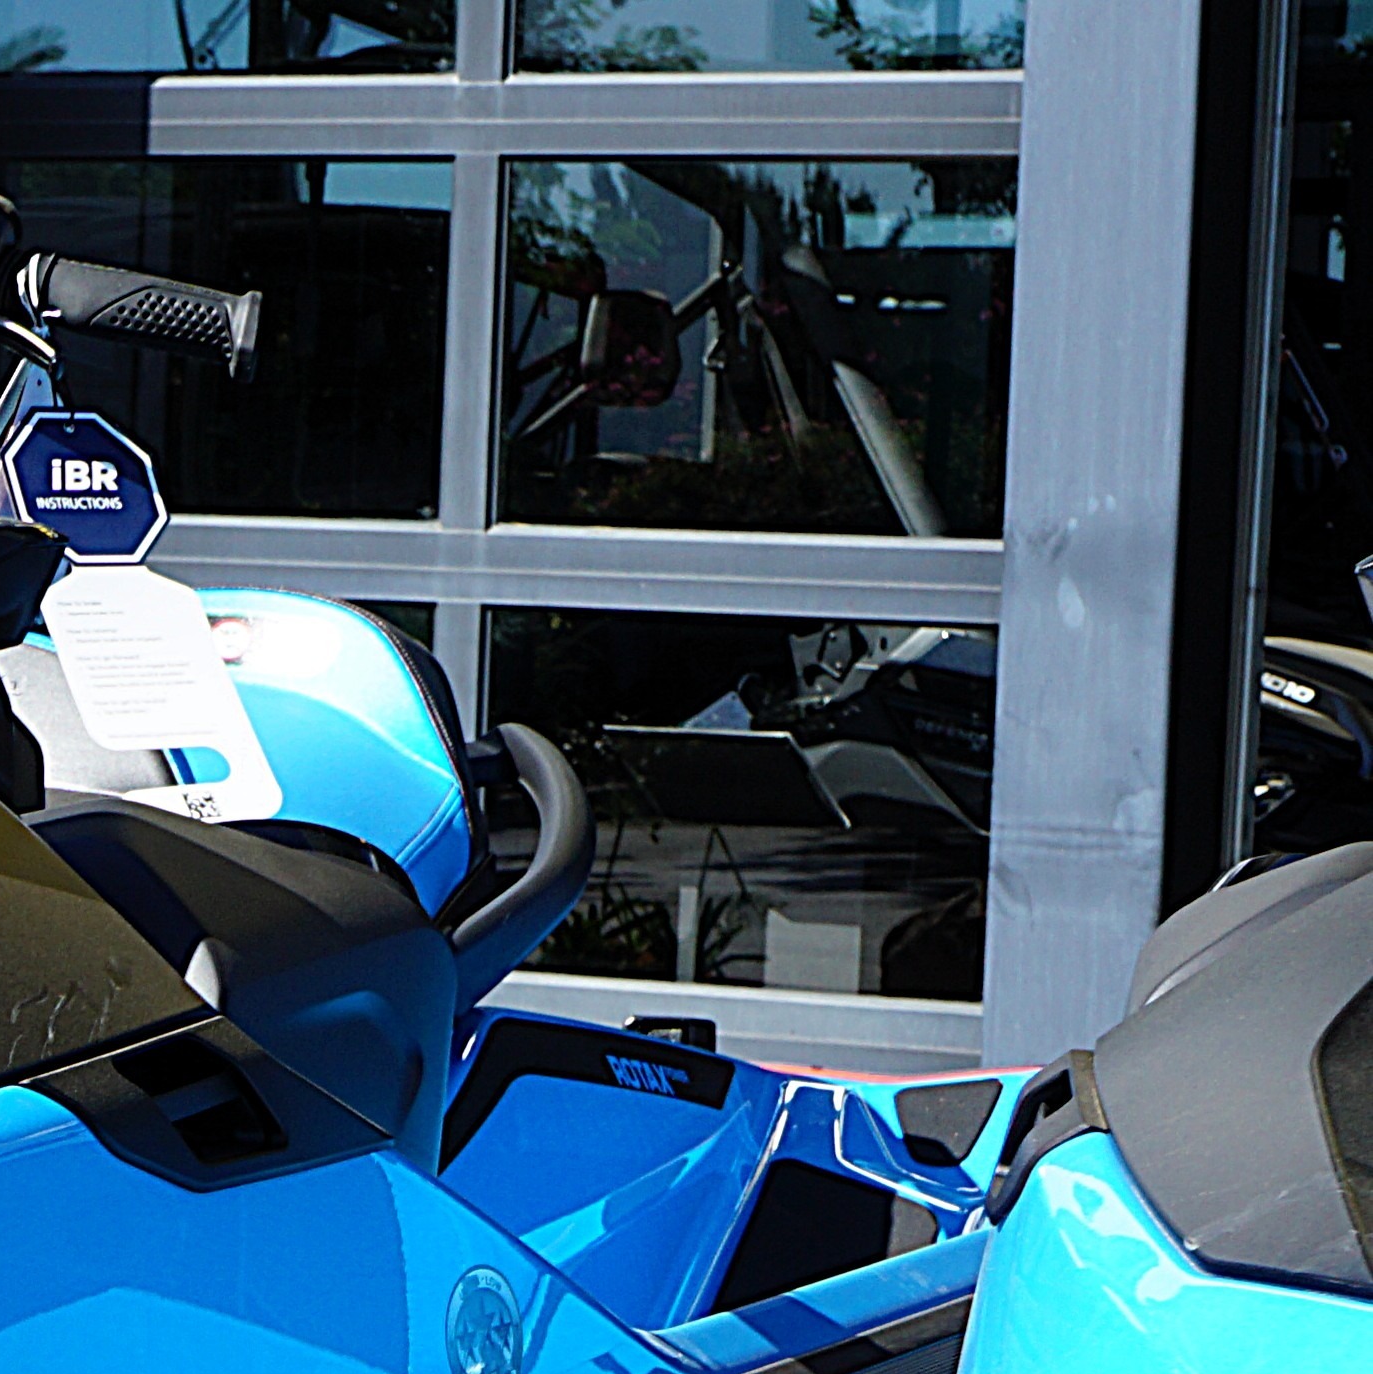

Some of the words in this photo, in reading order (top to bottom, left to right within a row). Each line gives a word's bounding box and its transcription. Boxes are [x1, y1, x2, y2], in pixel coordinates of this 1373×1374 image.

[51, 458, 119, 491] iBR
[35, 496, 123, 511] INSTRUCTIONS
[605, 1054, 675, 1097] ROTAX
